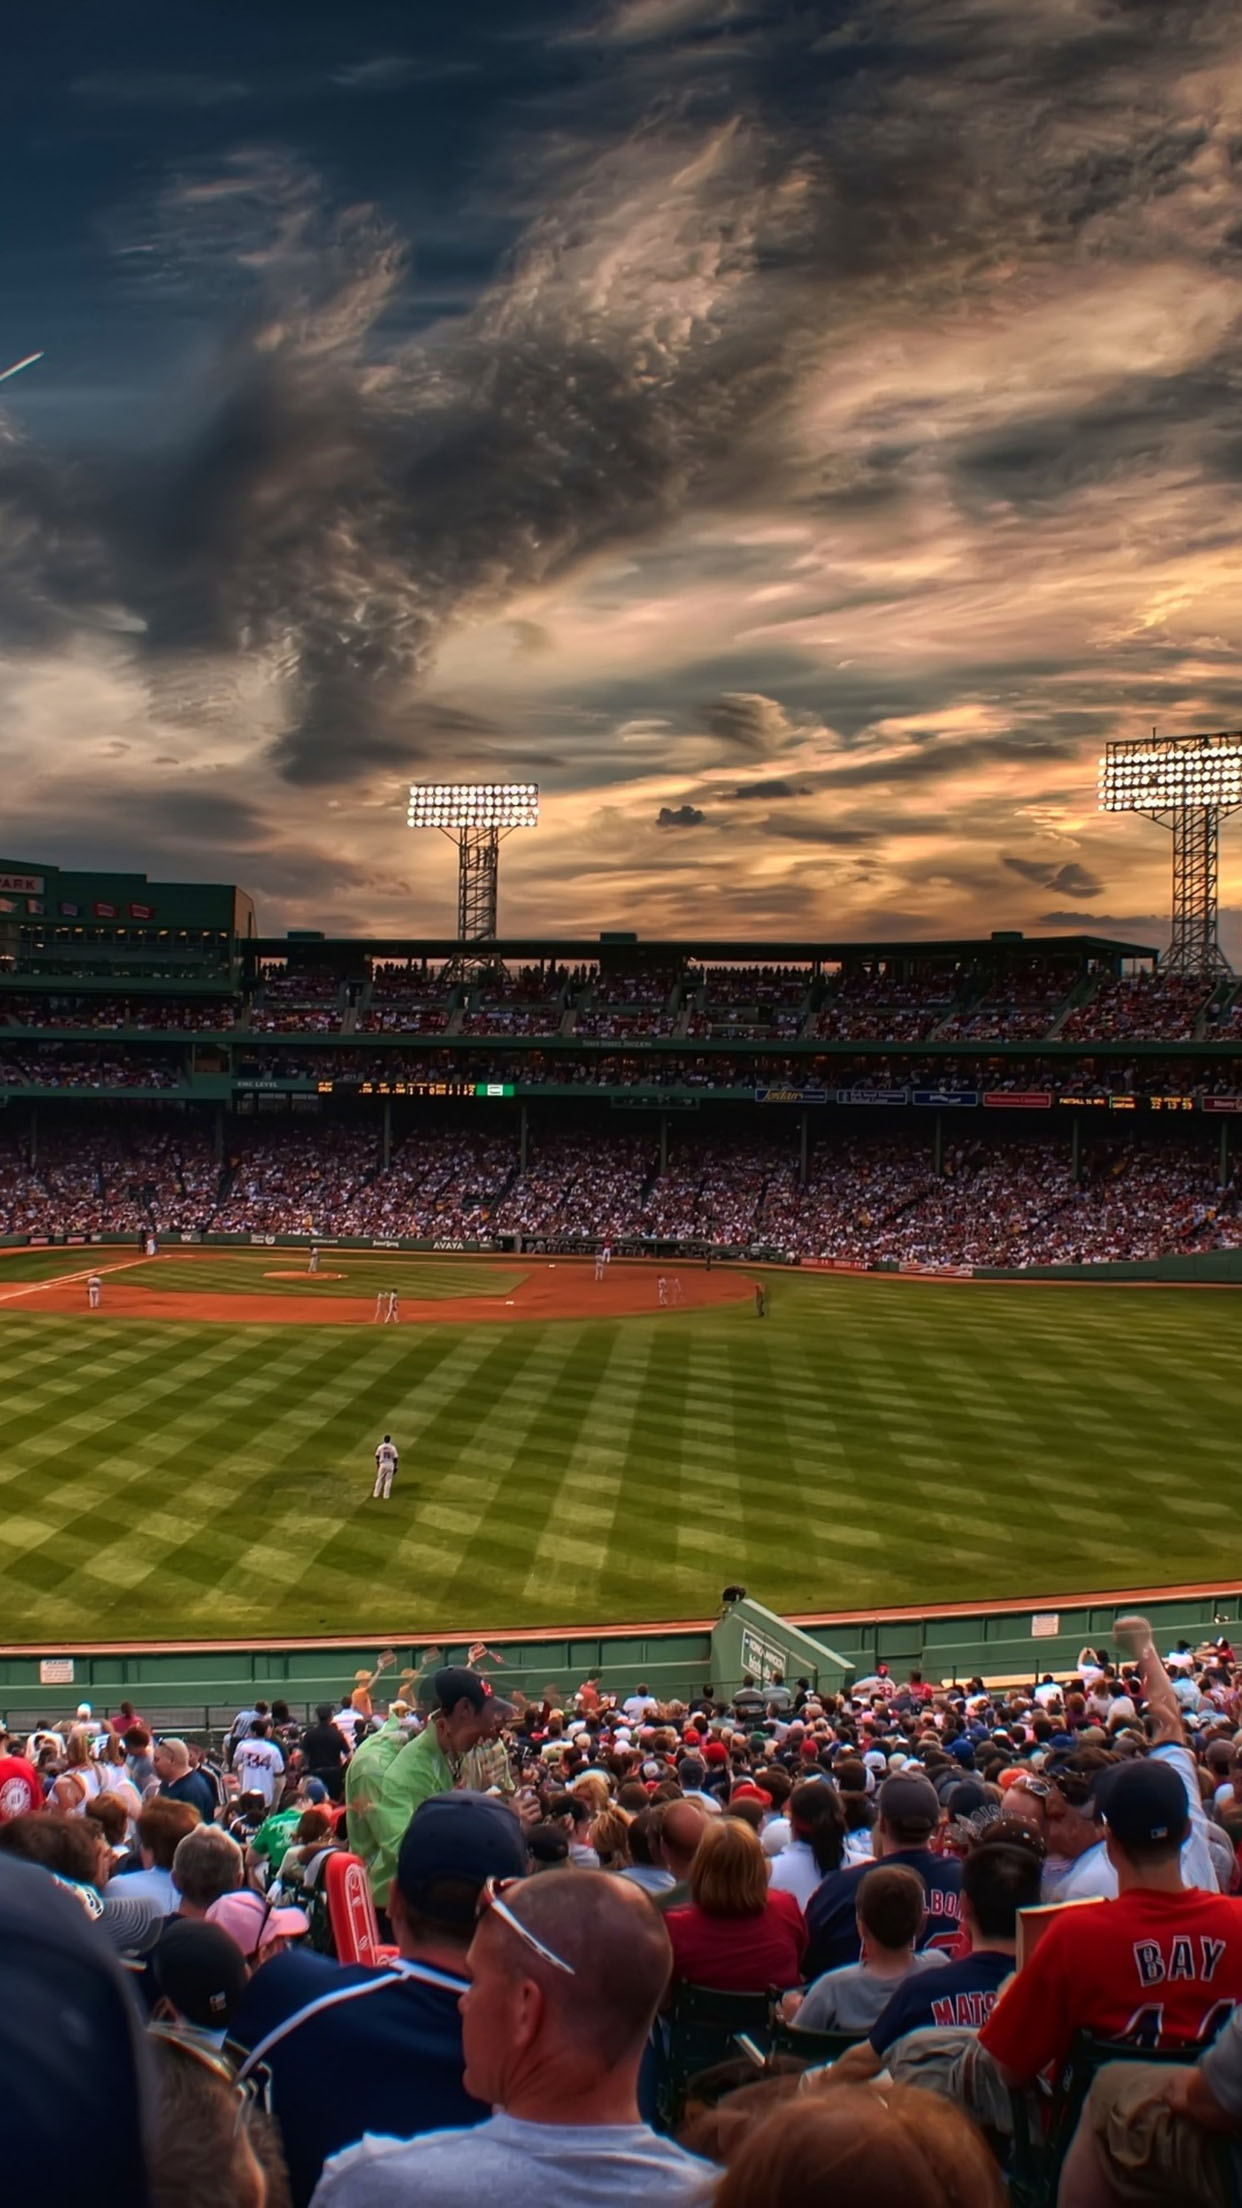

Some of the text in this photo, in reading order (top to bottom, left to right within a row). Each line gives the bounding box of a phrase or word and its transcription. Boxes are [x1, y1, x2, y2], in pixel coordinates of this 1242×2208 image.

[0, 877, 36, 890] ARK
[433, 1242, 465, 1250] AVAYA
[1133, 1935, 1227, 1988] BAY
